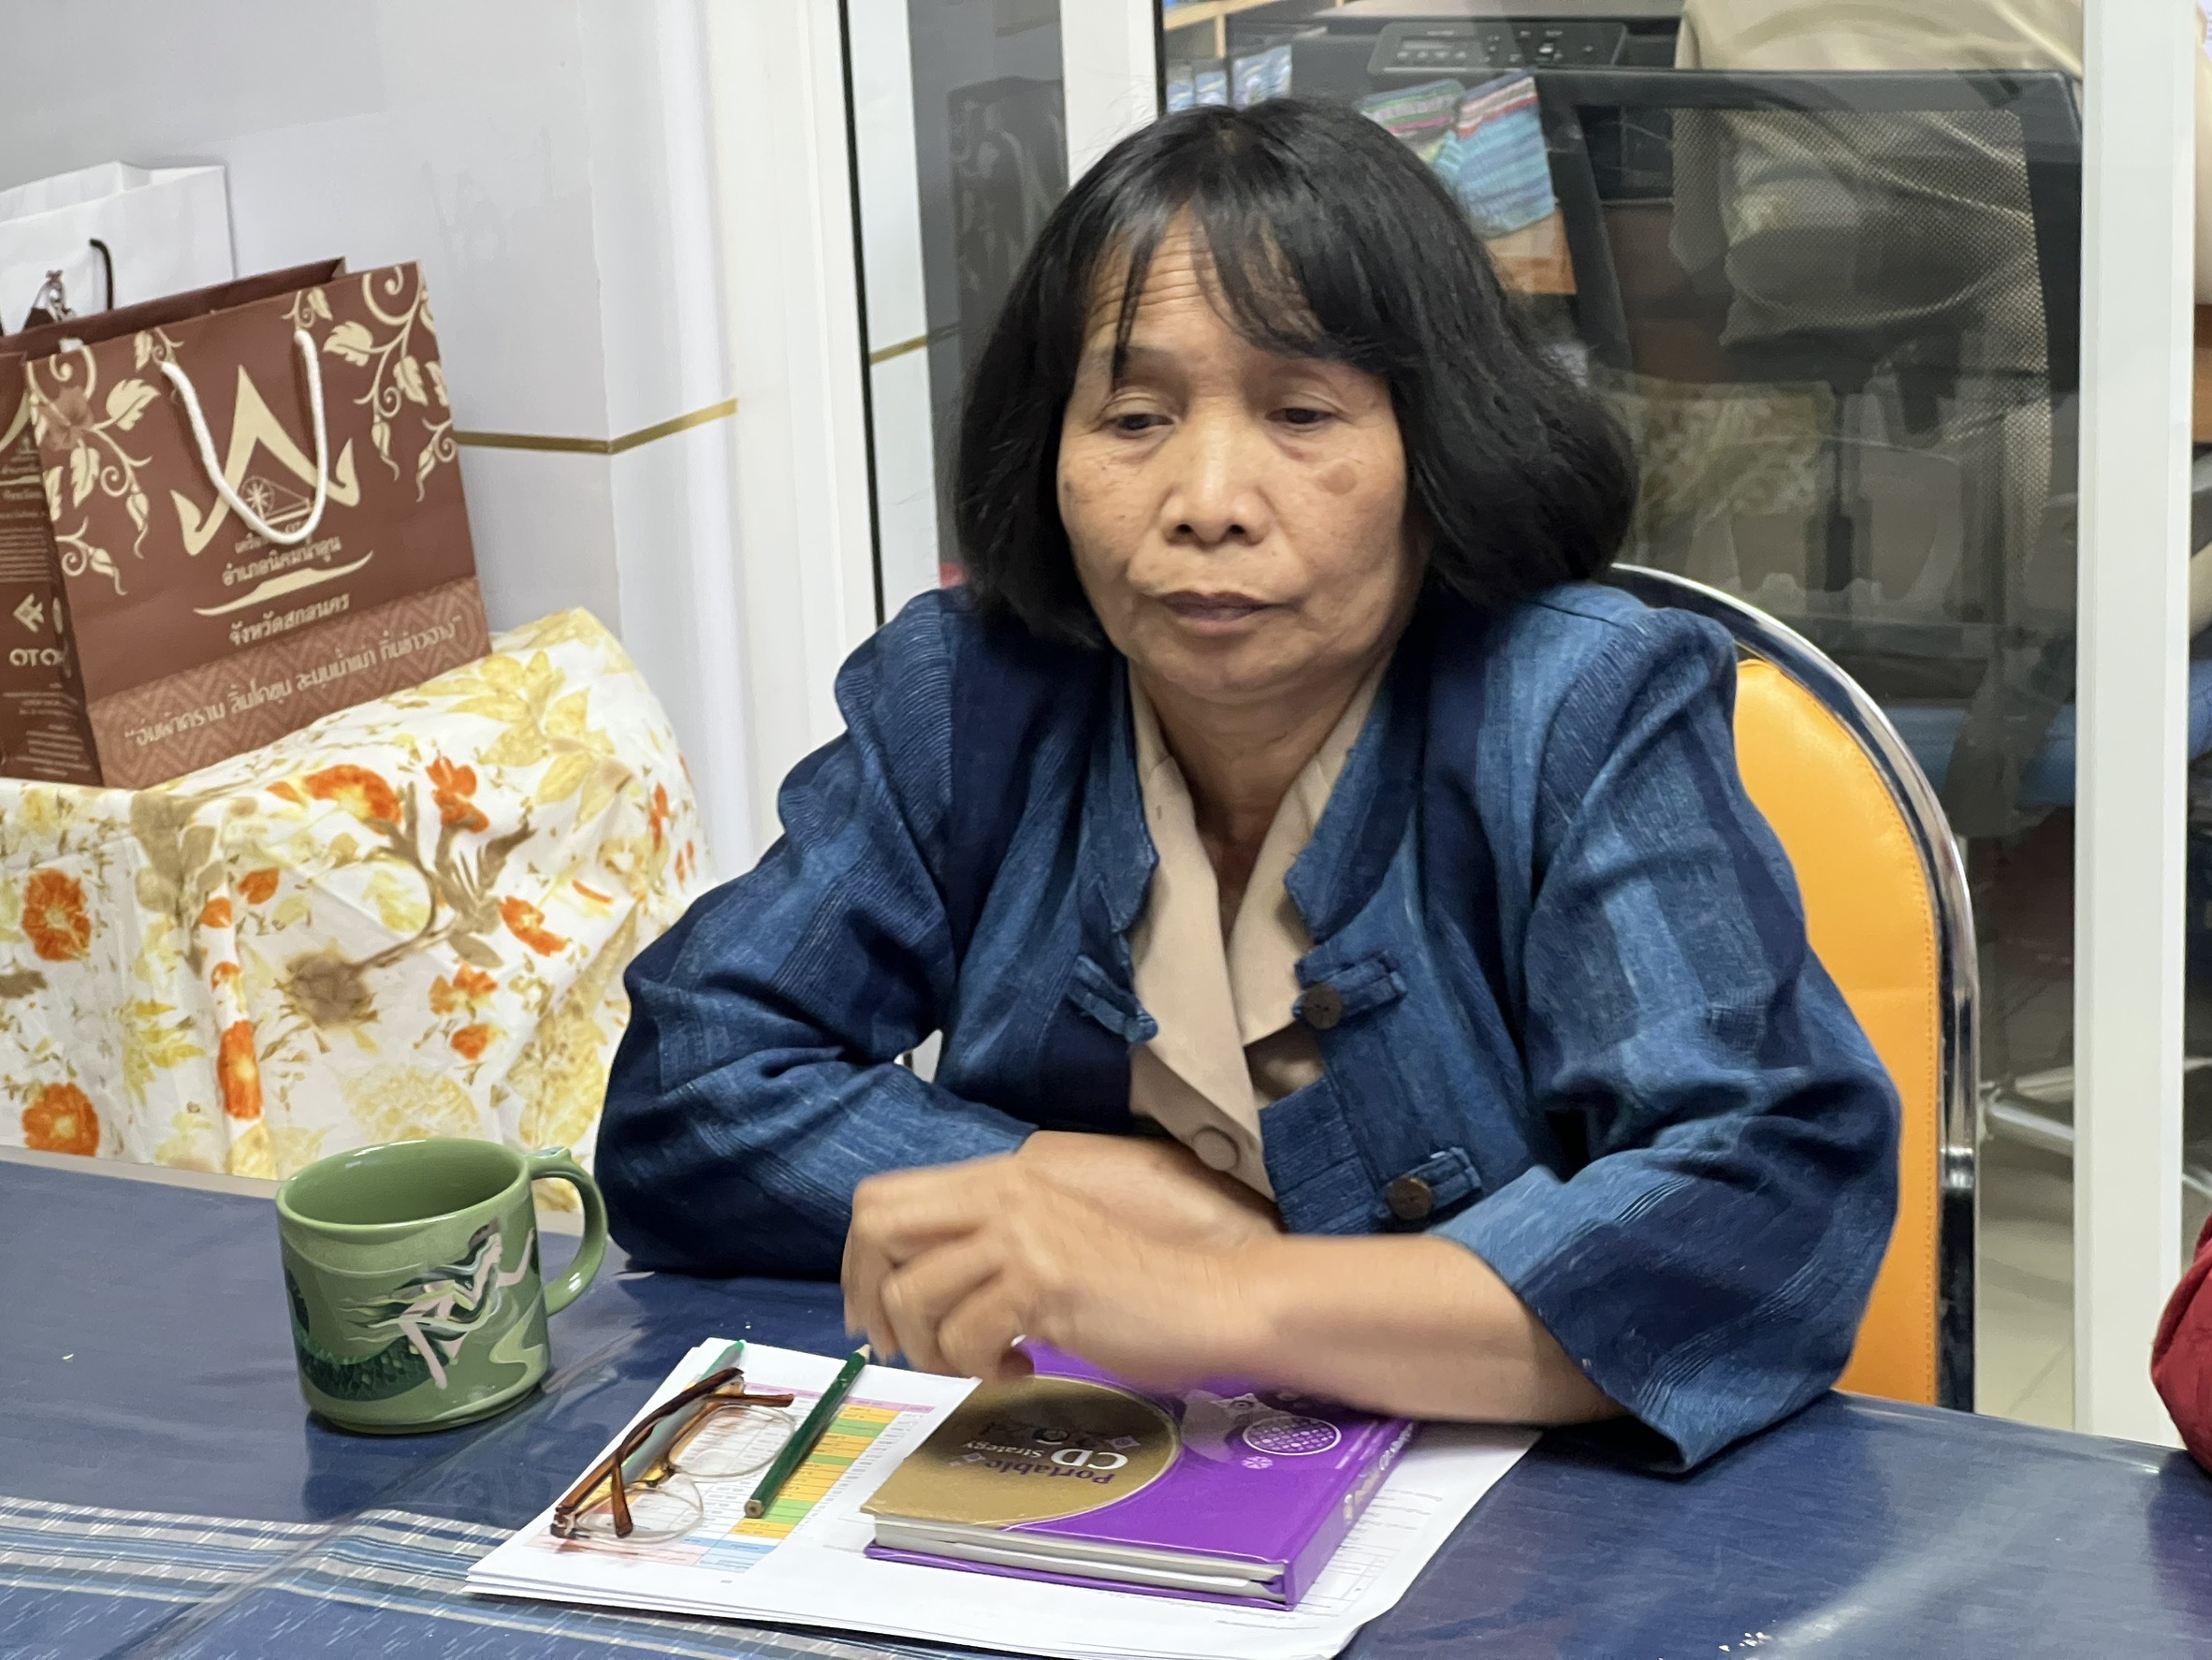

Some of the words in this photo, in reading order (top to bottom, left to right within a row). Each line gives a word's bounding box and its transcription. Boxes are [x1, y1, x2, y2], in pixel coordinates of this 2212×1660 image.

[229, 593, 350, 645] จังหวัดสกลนคร
[962, 1440, 1044, 1459] Strategy
[1051, 1449, 1128, 1470] CD
[986, 1460, 1116, 1485] Portable
